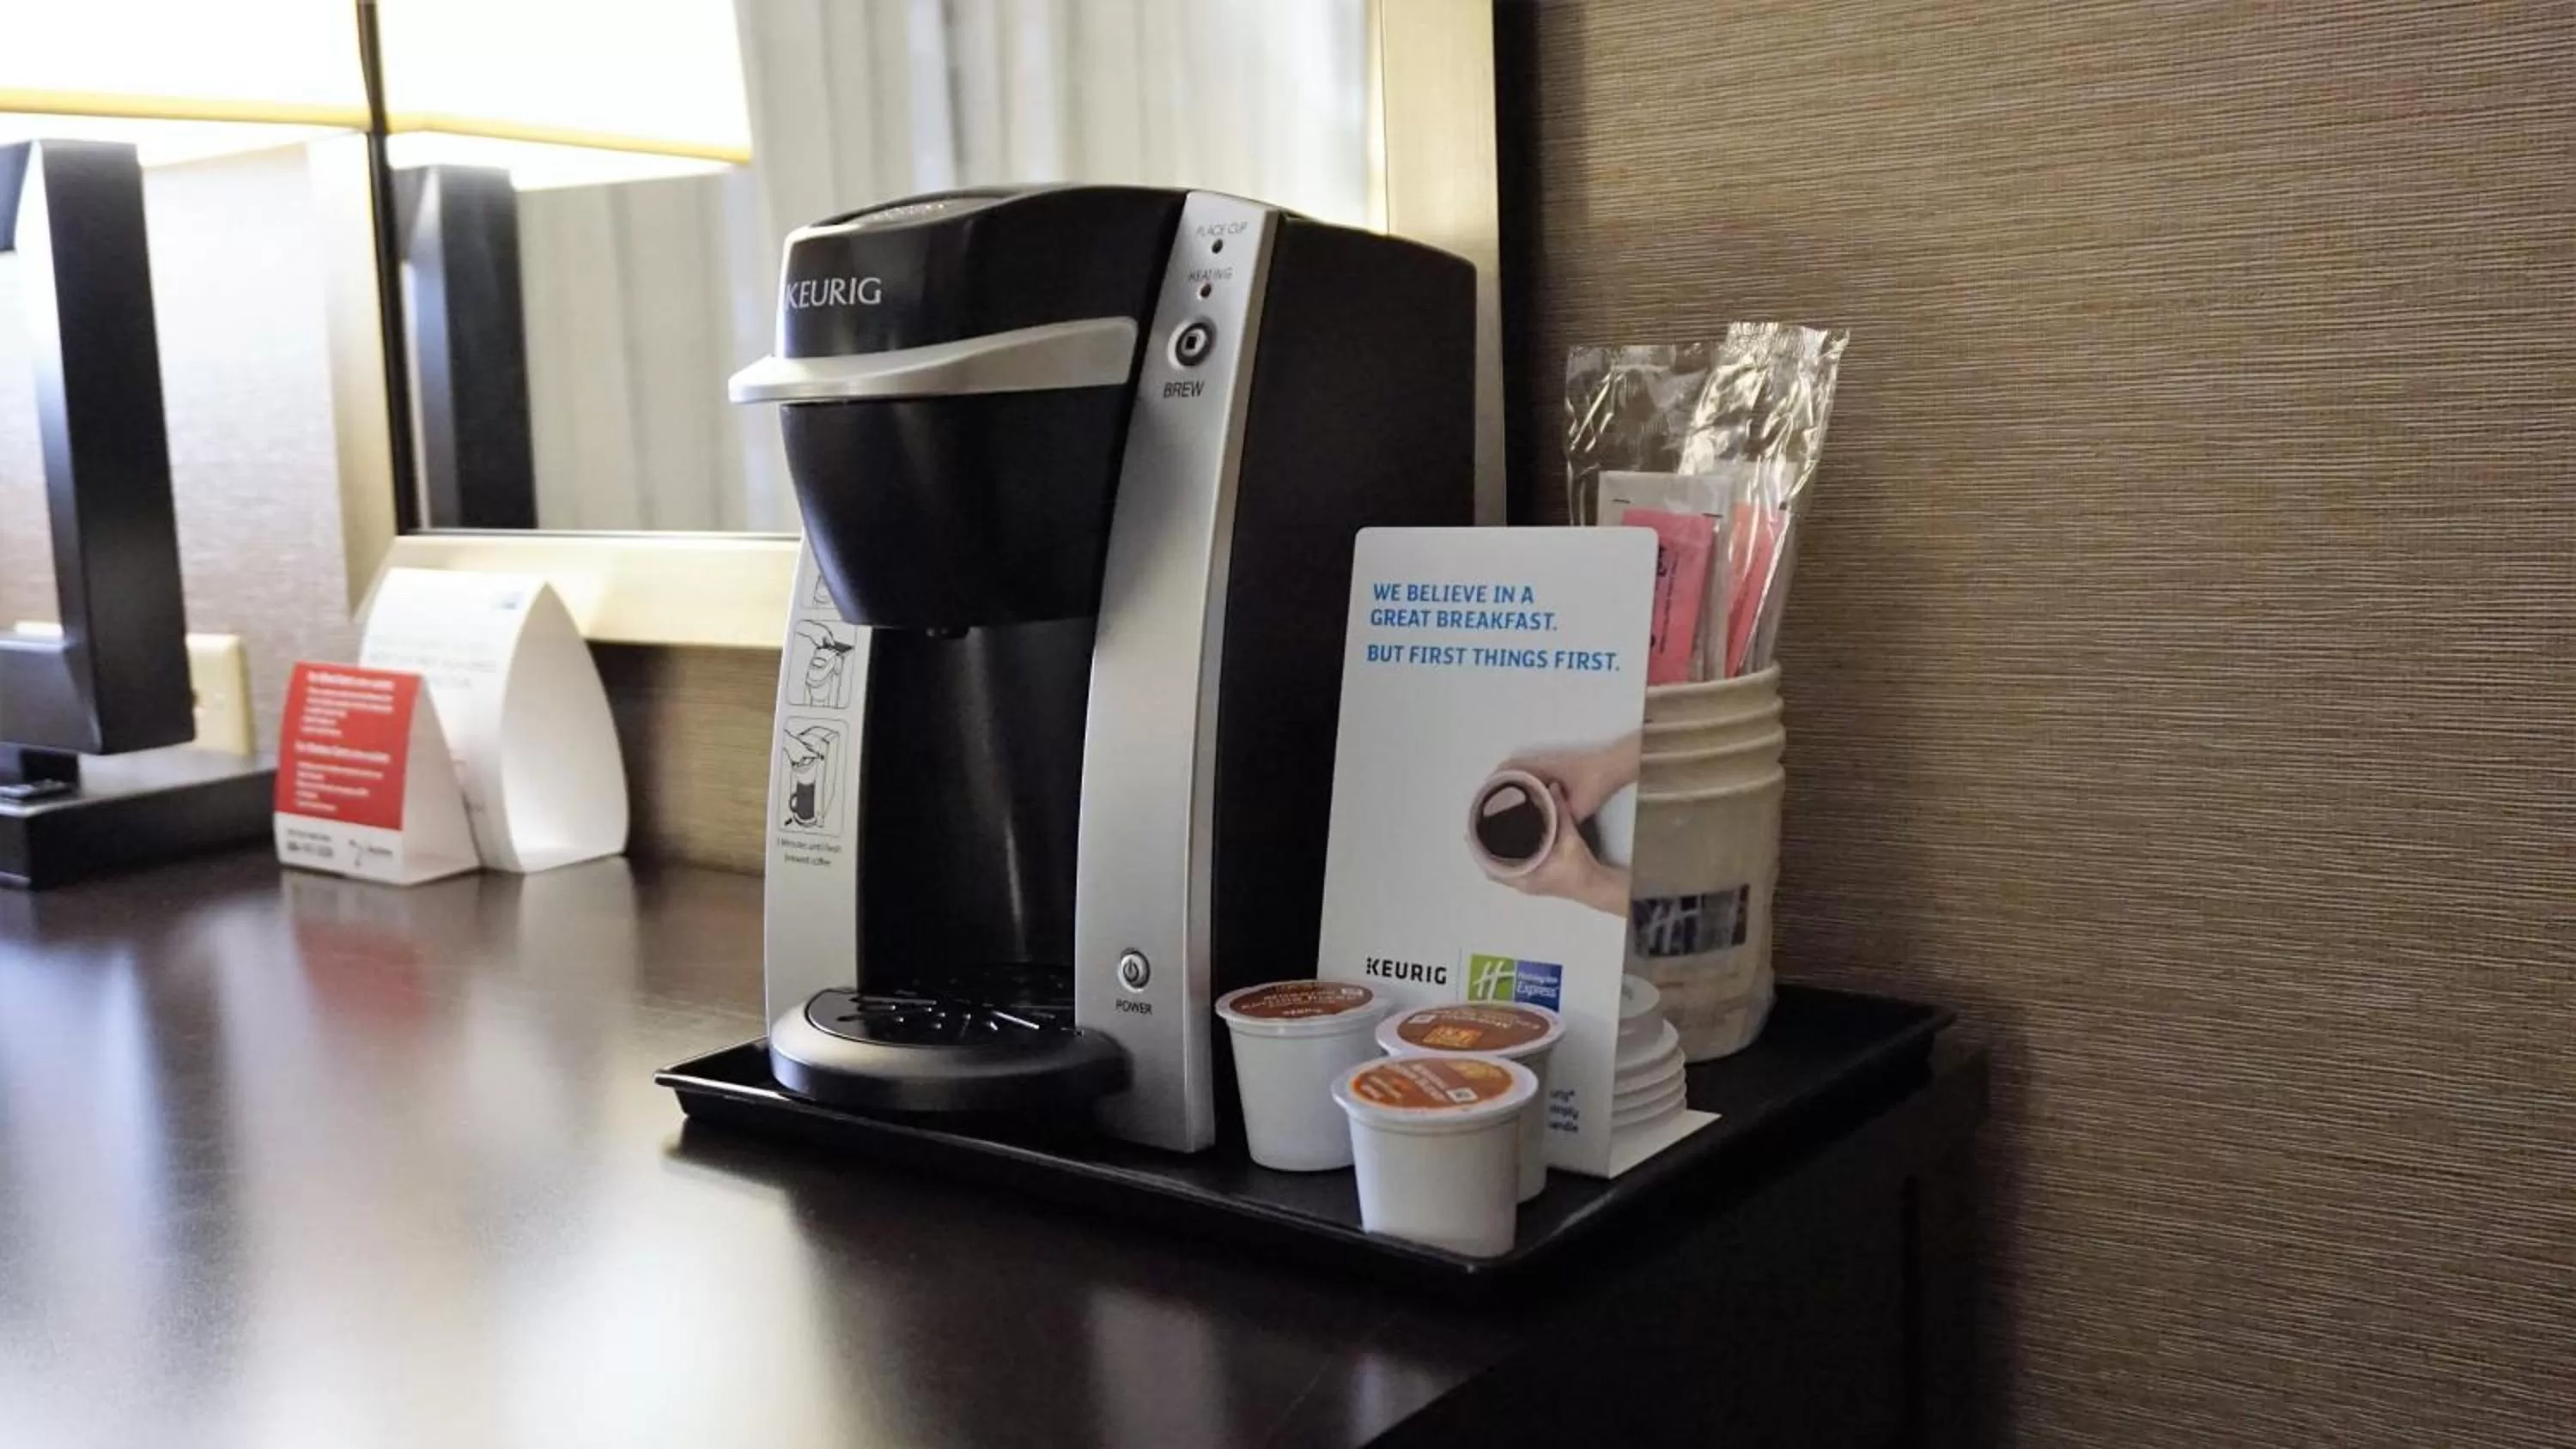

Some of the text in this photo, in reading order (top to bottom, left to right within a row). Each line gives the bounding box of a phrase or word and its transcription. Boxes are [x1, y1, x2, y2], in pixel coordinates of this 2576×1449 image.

[1188, 266, 1233, 282] HEATING
[785, 276, 882, 309] KEURIG
[1163, 380, 1204, 399] BREW
[1373, 583, 1534, 604] WE BELIEVE IN A
[1370, 609, 1558, 631] GREAT BREAKFAST.
[1367, 644, 1620, 671] BUT FIRST THINGS FIRST.
[1366, 956, 1447, 985] KEURIG
[1516, 981, 1557, 997] Express
[1115, 998, 1152, 1015] POWER
